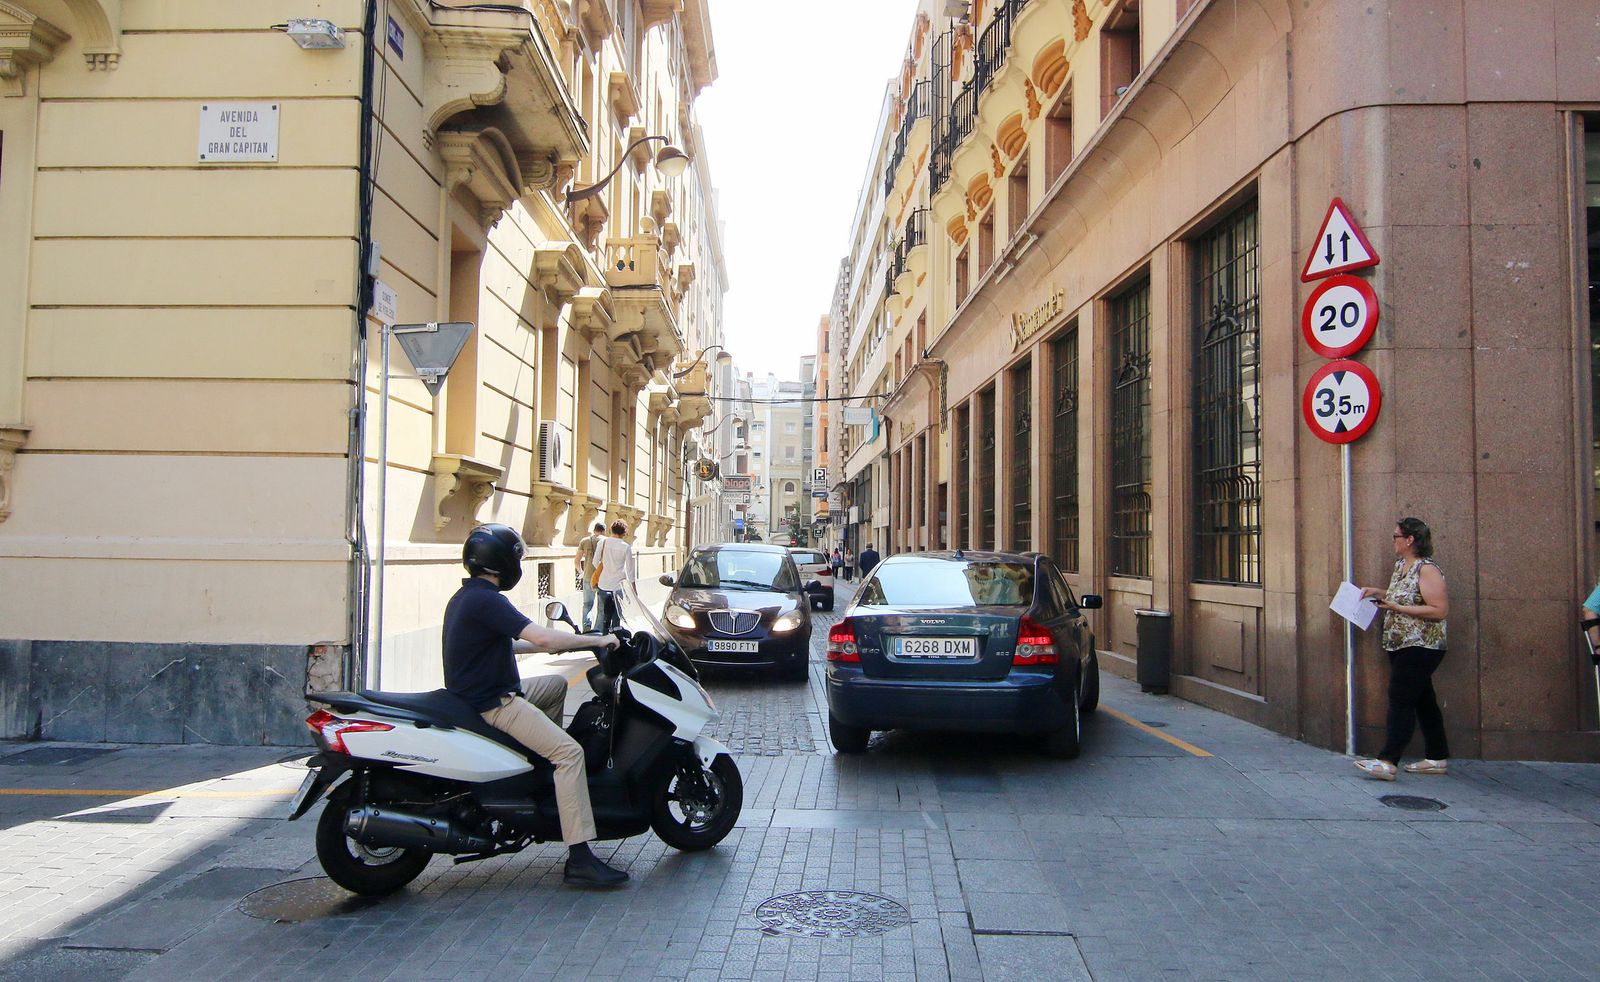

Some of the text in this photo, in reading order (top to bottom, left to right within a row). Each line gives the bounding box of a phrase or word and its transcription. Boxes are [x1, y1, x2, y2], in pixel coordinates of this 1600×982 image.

[220, 110, 258, 122] AVENIDA
[229, 126, 247, 138] DEL
[208, 142, 268, 153] GRAN CAPITAN
[1319, 301, 1360, 332] 20
[714, 642, 756, 651] 9890 FTY
[905, 640, 971, 654] 6268 DXM
